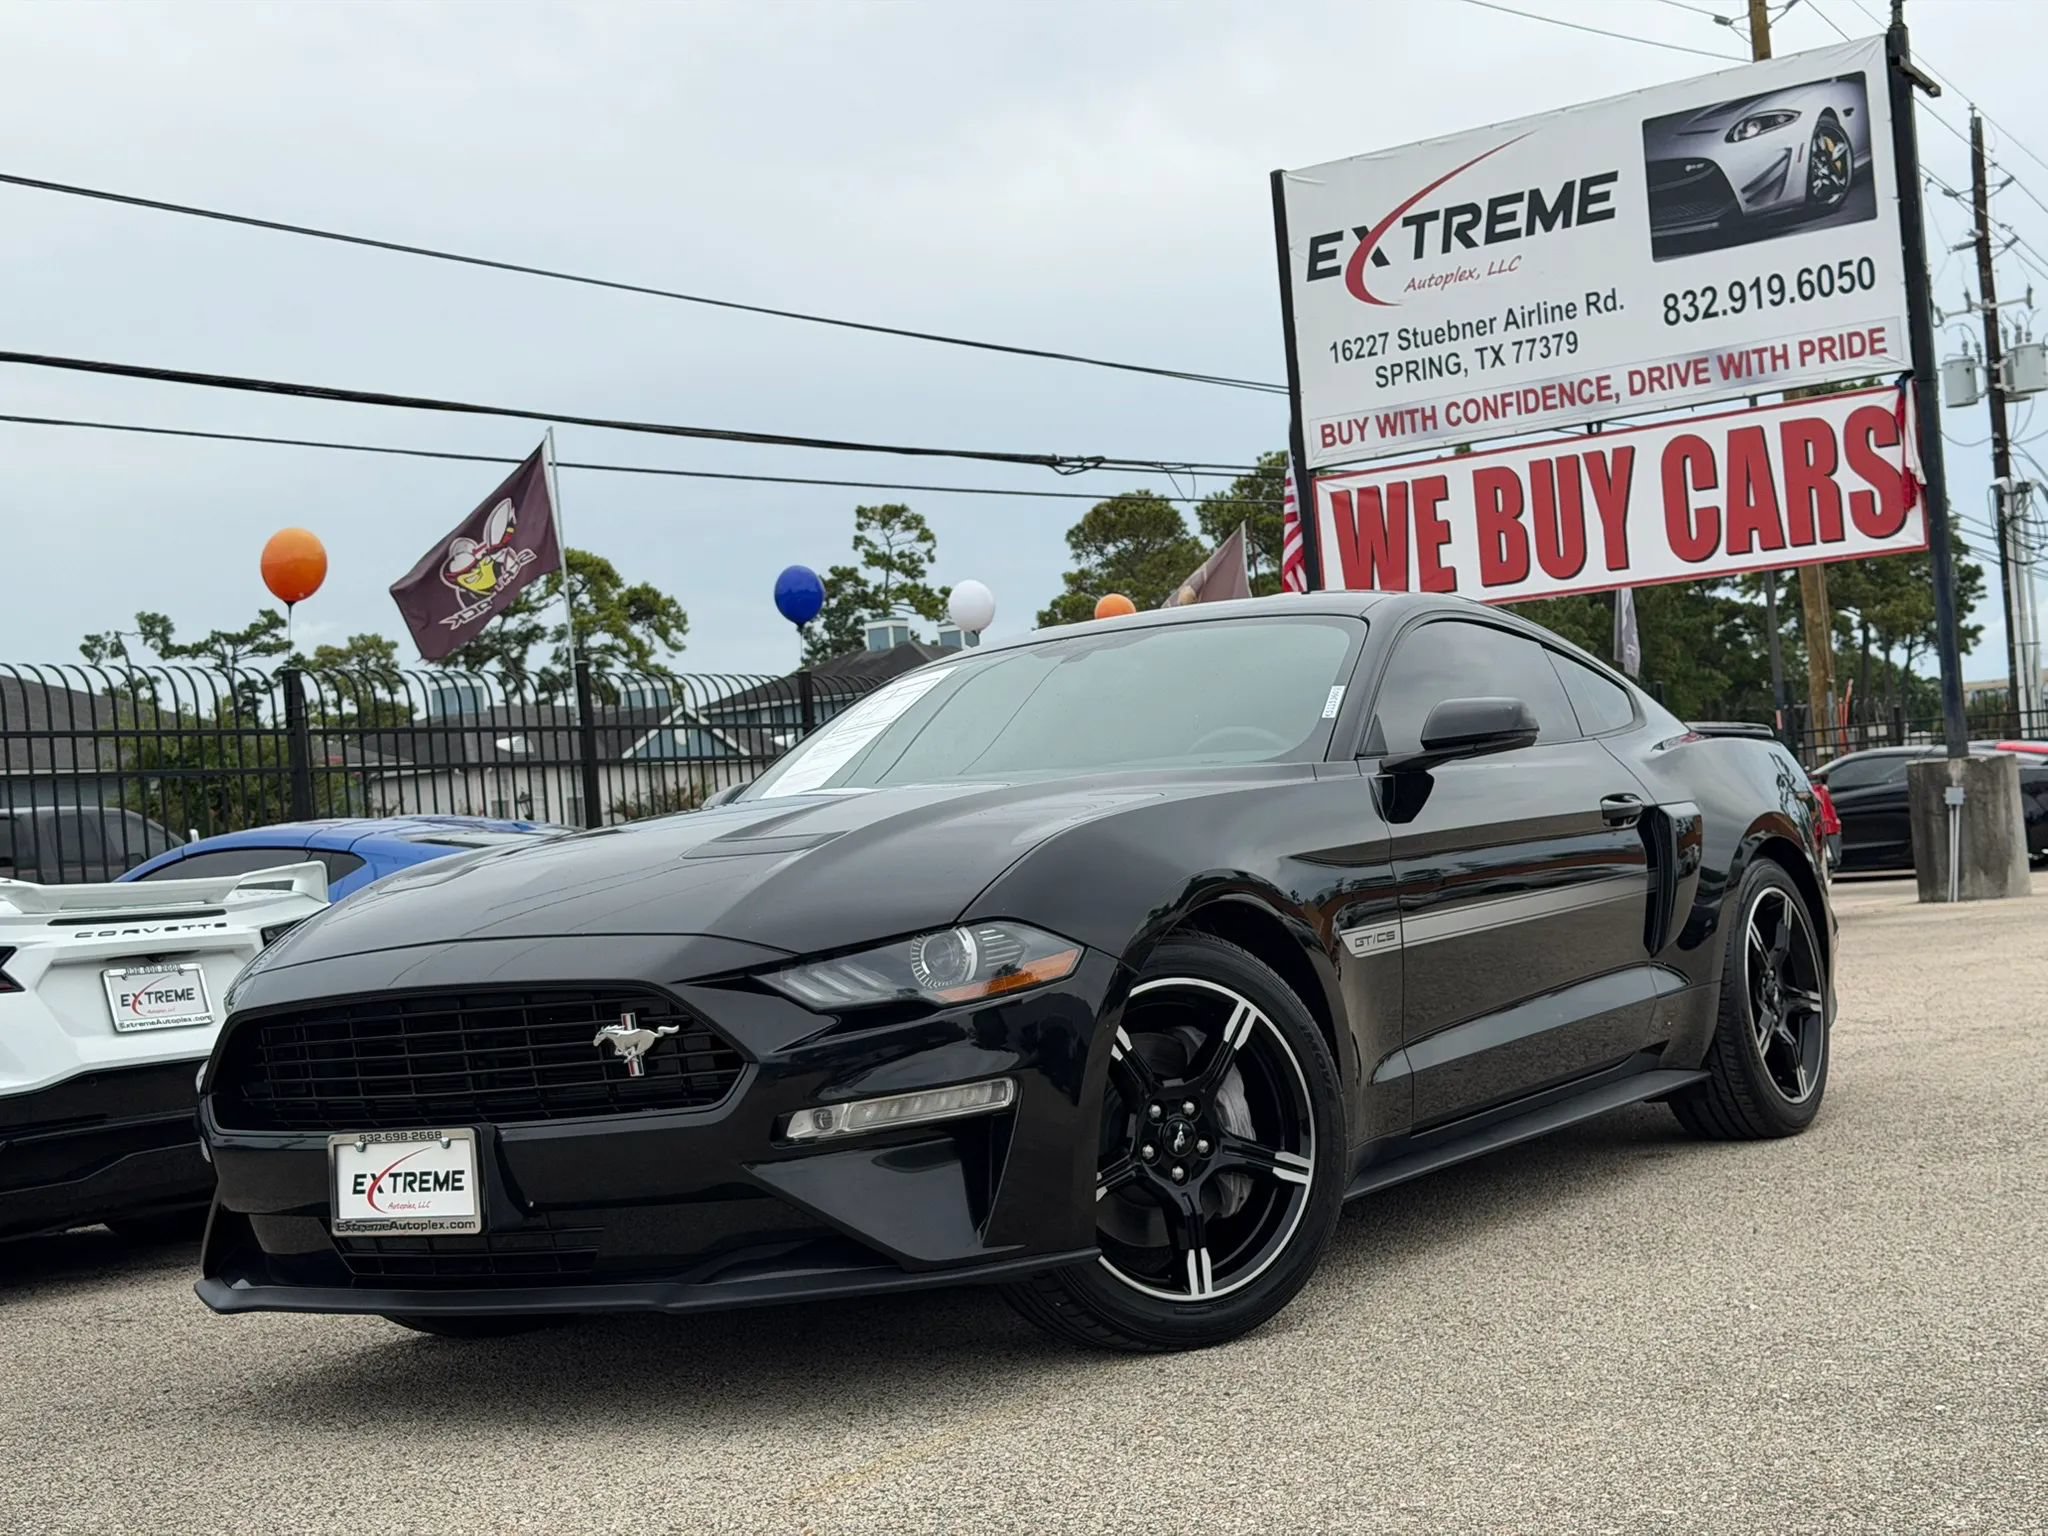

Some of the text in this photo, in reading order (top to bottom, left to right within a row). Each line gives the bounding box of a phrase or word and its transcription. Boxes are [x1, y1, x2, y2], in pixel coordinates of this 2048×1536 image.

[1306, 170, 1618, 282] EXTREME
[1403, 255, 1522, 292] Autoplex, LLC
[1663, 256, 1876, 326] 832.919.6050
[1329, 288, 1625, 364] 16227 Stuebner Airline Rd.
[1374, 330, 1579, 388] SPRING, TX 77379
[1320, 327, 1887, 449] BUY WITH CONFIDENCE, DRIVE WITH PRIDE
[1330, 405, 1908, 593] WE BUY CARS
[75, 922, 227, 938] CORVETTE
[1355, 930, 1396, 948] GT/CS
[120, 987, 195, 1007] EXTREME
[352, 1170, 465, 1195] EXTREME
[336, 1220, 476, 1232] ExtremeAutoplex.com
